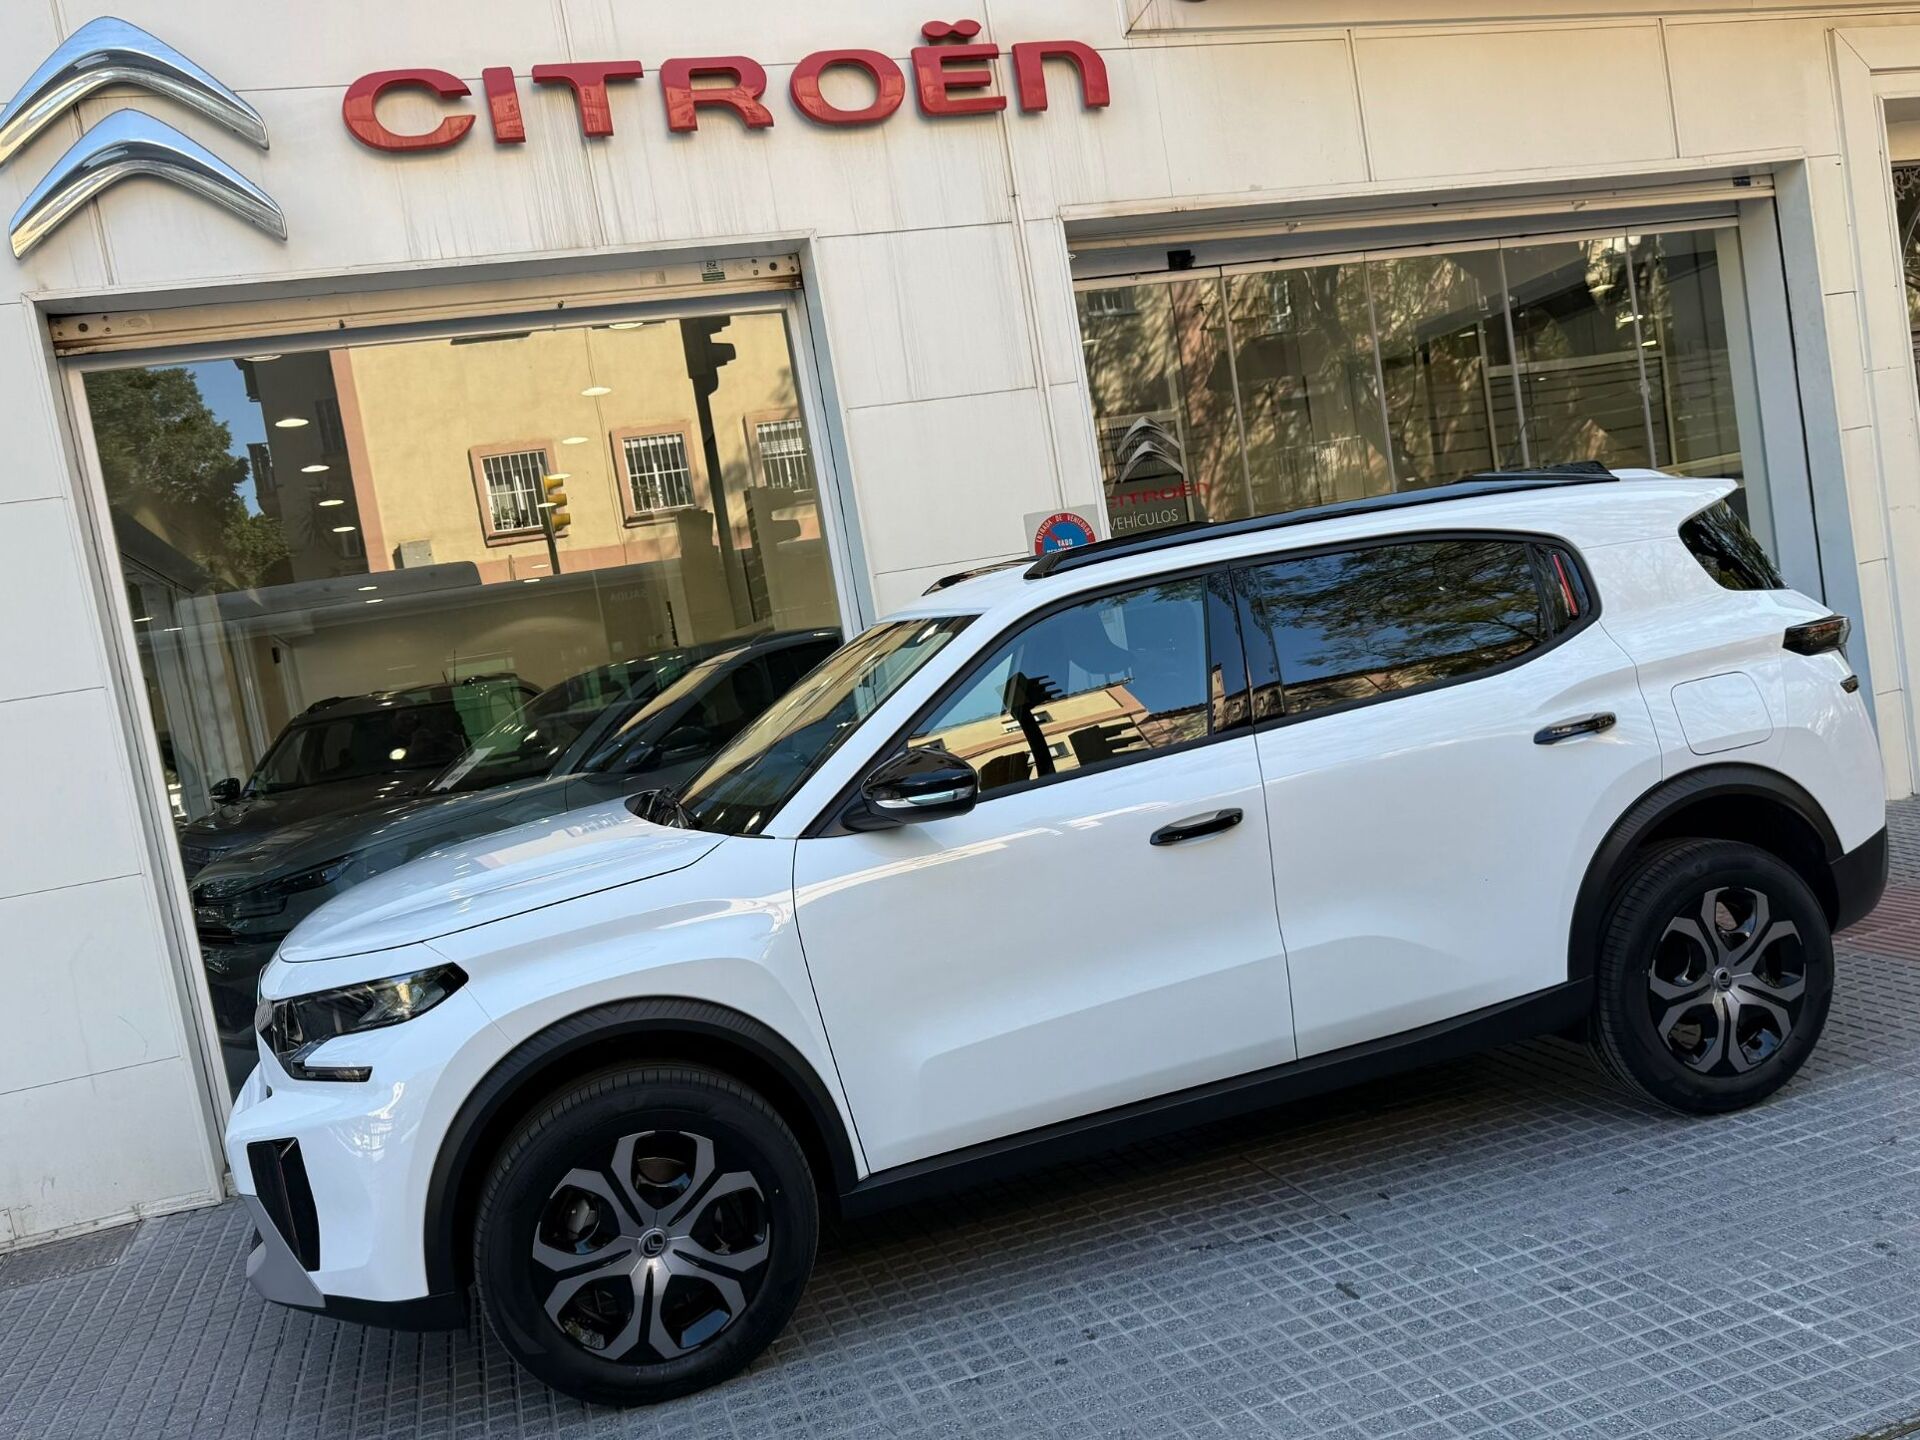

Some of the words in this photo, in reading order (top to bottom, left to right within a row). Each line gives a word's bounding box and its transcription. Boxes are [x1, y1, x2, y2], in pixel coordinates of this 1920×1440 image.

[1055, 514, 1063, 522] DE
[1109, 509, 1178, 531] VEHÍCULOS
[1057, 538, 1073, 547] VADO
